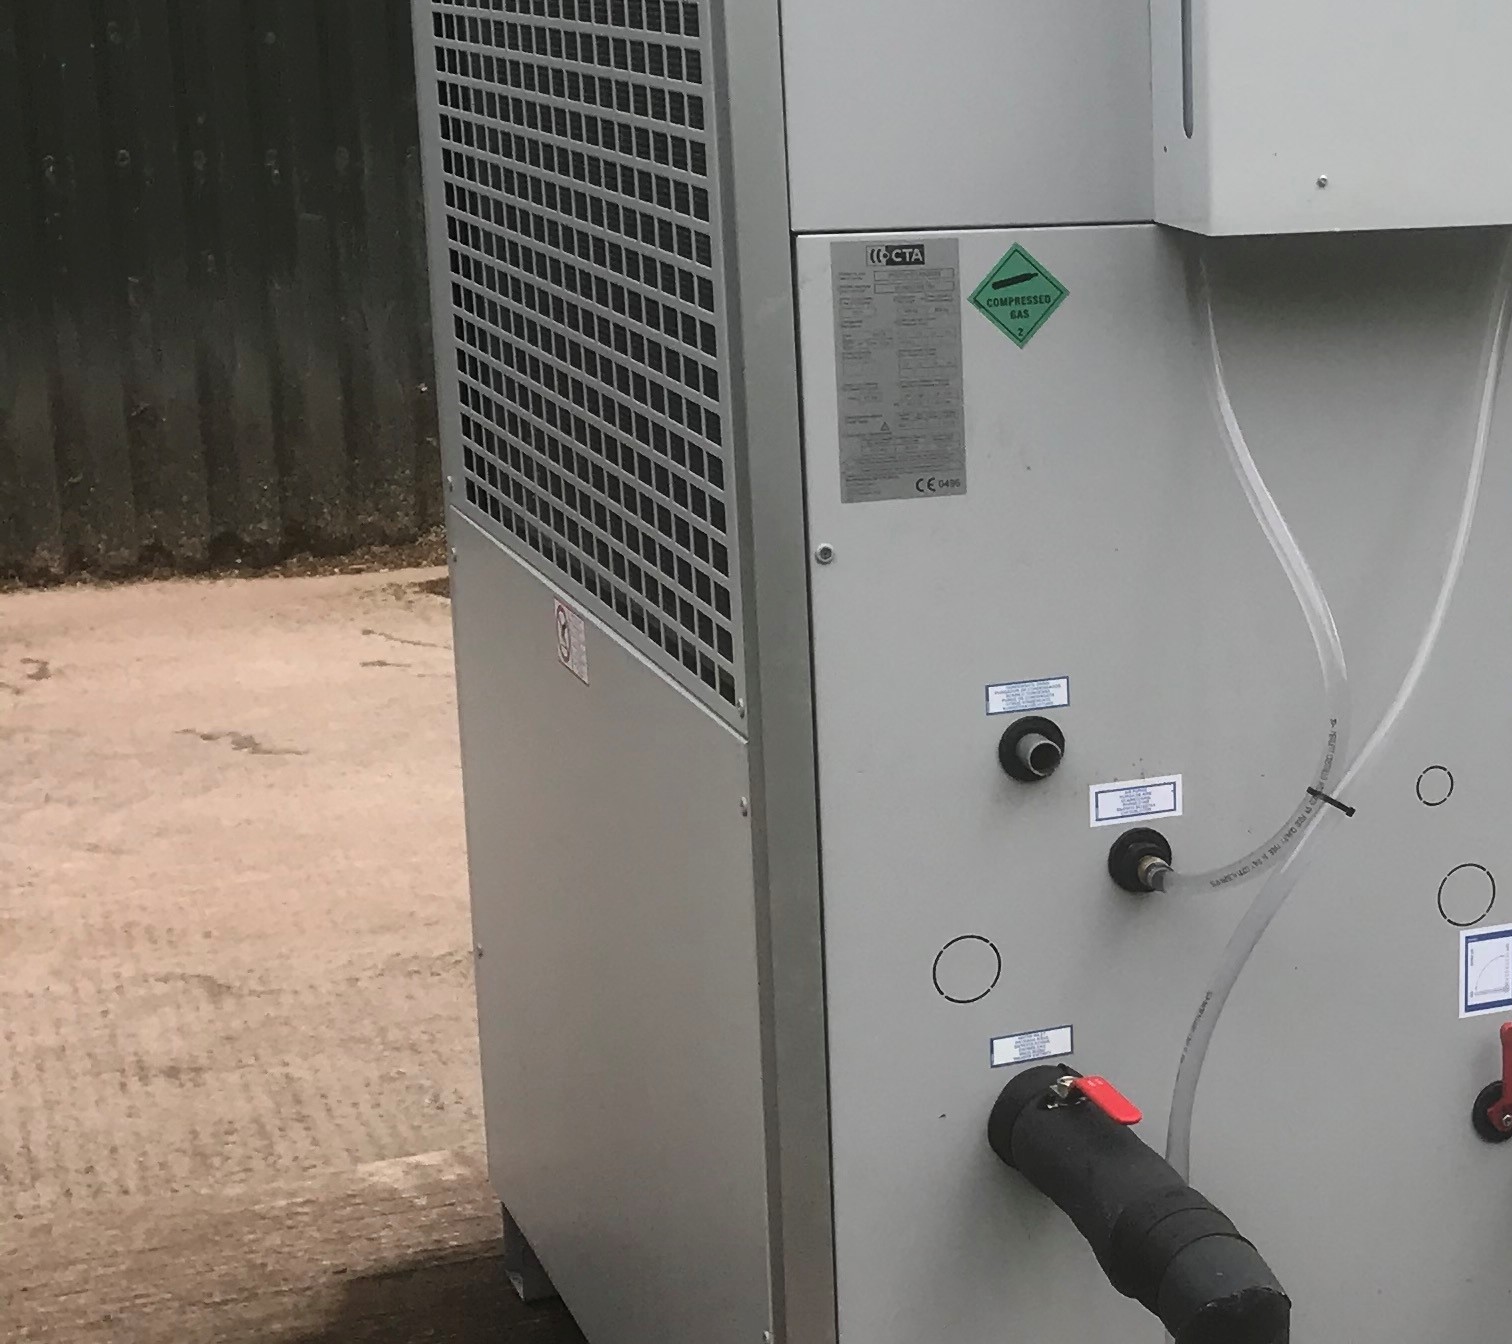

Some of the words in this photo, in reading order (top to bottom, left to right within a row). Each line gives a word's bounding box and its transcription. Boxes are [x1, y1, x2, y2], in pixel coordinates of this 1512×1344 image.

[891, 248, 923, 262] CTA
[986, 294, 1051, 308] COMPRESSED
[1010, 309, 1030, 320] GAS
[1017, 327, 1024, 337] 2
